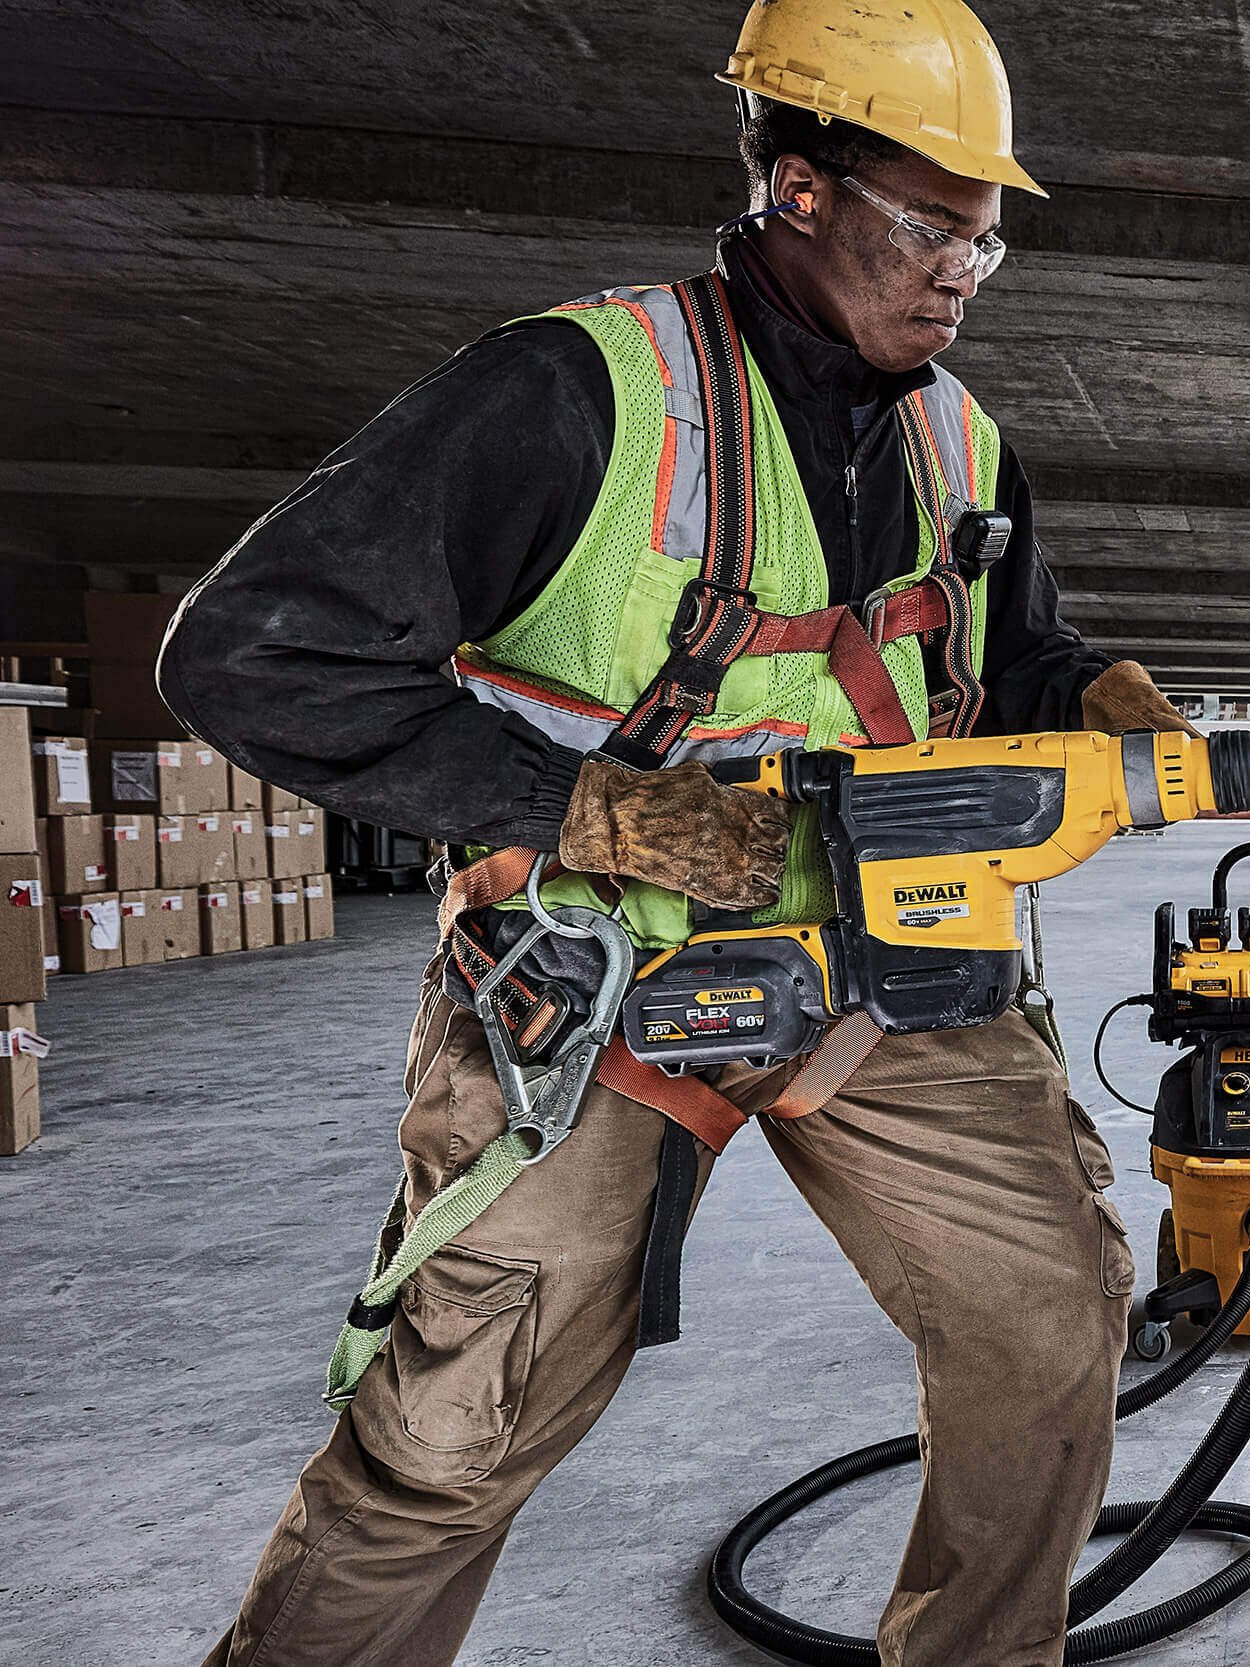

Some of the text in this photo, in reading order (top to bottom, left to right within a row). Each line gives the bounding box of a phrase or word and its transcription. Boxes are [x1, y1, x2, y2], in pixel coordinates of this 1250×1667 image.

[894, 884, 967, 904] DEWALT
[906, 907, 961, 917] BRUSHLESS
[710, 990, 752, 1002] DEWALT
[686, 1006, 730, 1021] FLEX
[647, 1024, 671, 1036] 20V
[688, 1018, 730, 1030] VOLT
